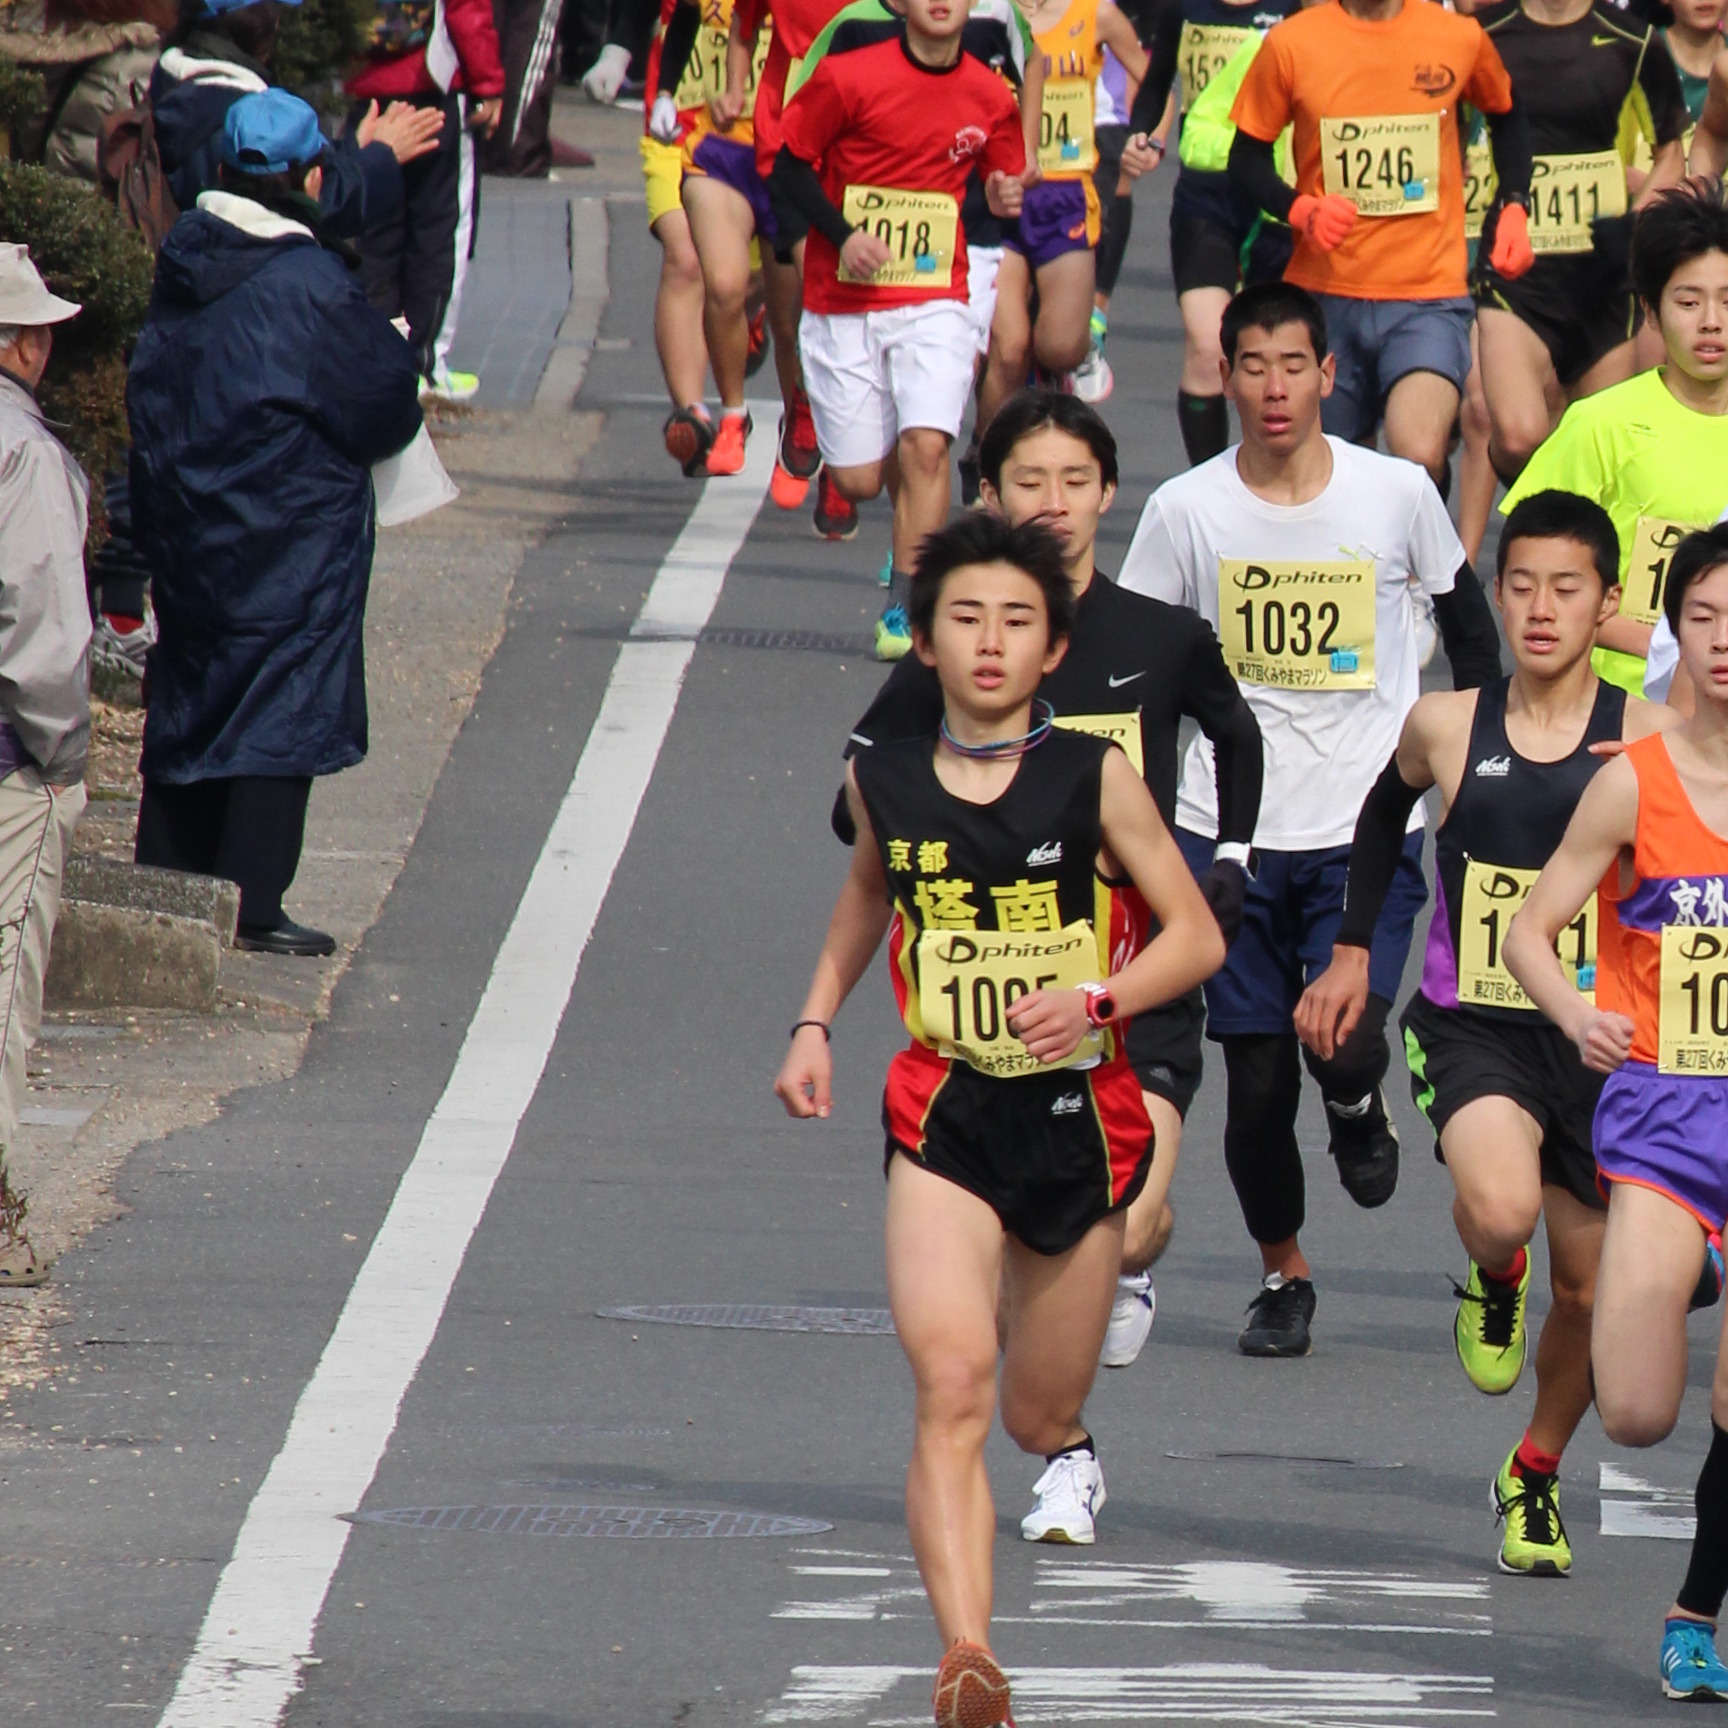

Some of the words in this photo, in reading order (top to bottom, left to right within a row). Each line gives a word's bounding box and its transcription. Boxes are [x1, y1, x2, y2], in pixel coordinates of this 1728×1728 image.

[1040, 110, 1070, 140] 04
[1335, 145, 1414, 190] 1246
[1529, 181, 1600, 227] 1411
[1272, 570, 1363, 590] phiten
[1235, 599, 1341, 658] 1032
[888, 838, 950, 873] 京都
[914, 878, 1063, 933] 塔南
[980, 935, 1084, 962] phiten
